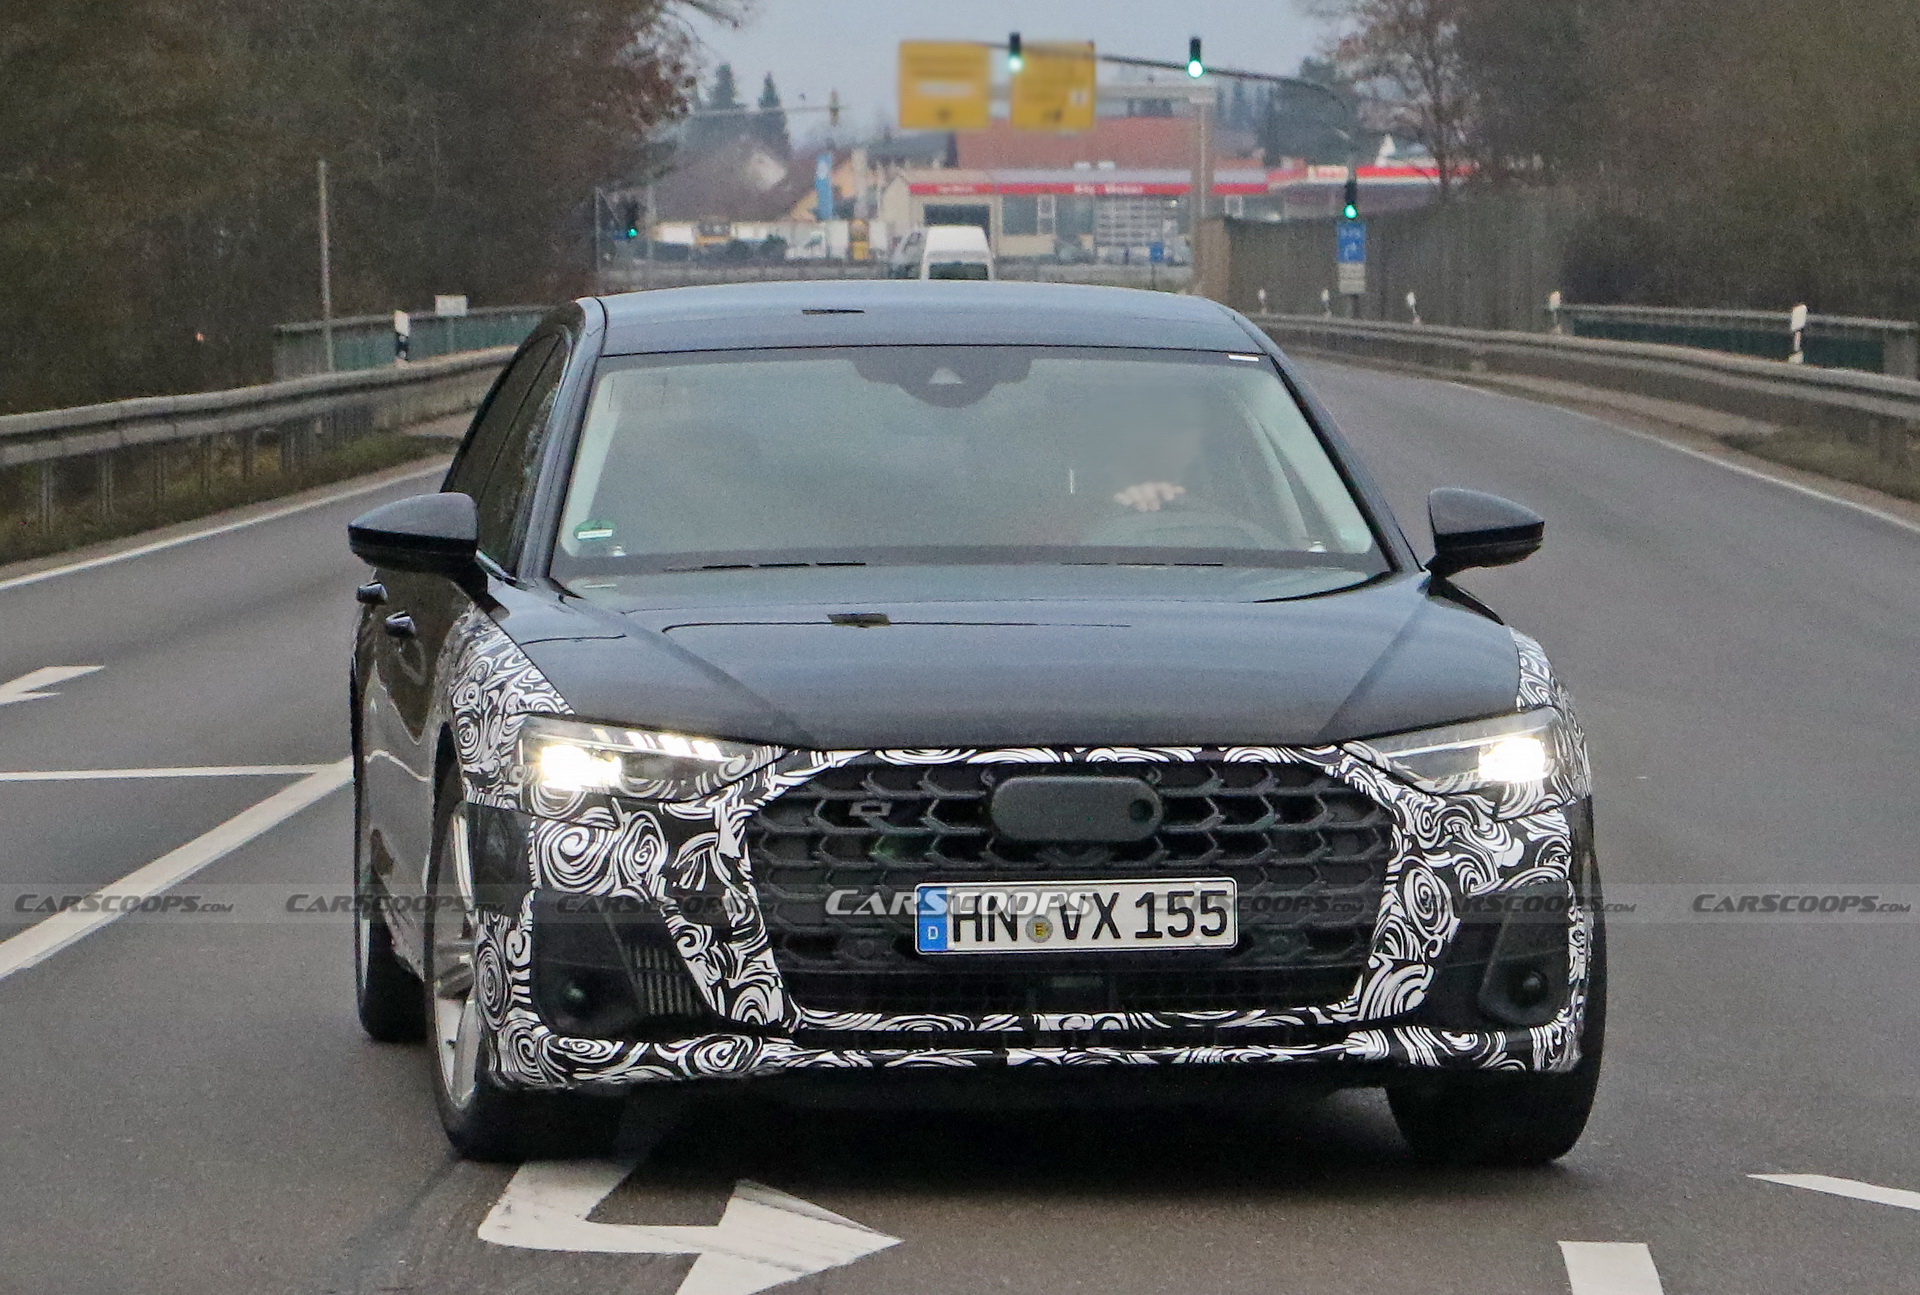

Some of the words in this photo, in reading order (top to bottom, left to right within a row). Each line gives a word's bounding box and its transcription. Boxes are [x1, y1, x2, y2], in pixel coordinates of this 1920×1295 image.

[952, 894, 1018, 942] HN
[1058, 892, 1121, 940] VX
[1135, 890, 1228, 938] 155
[927, 926, 939, 941] D
